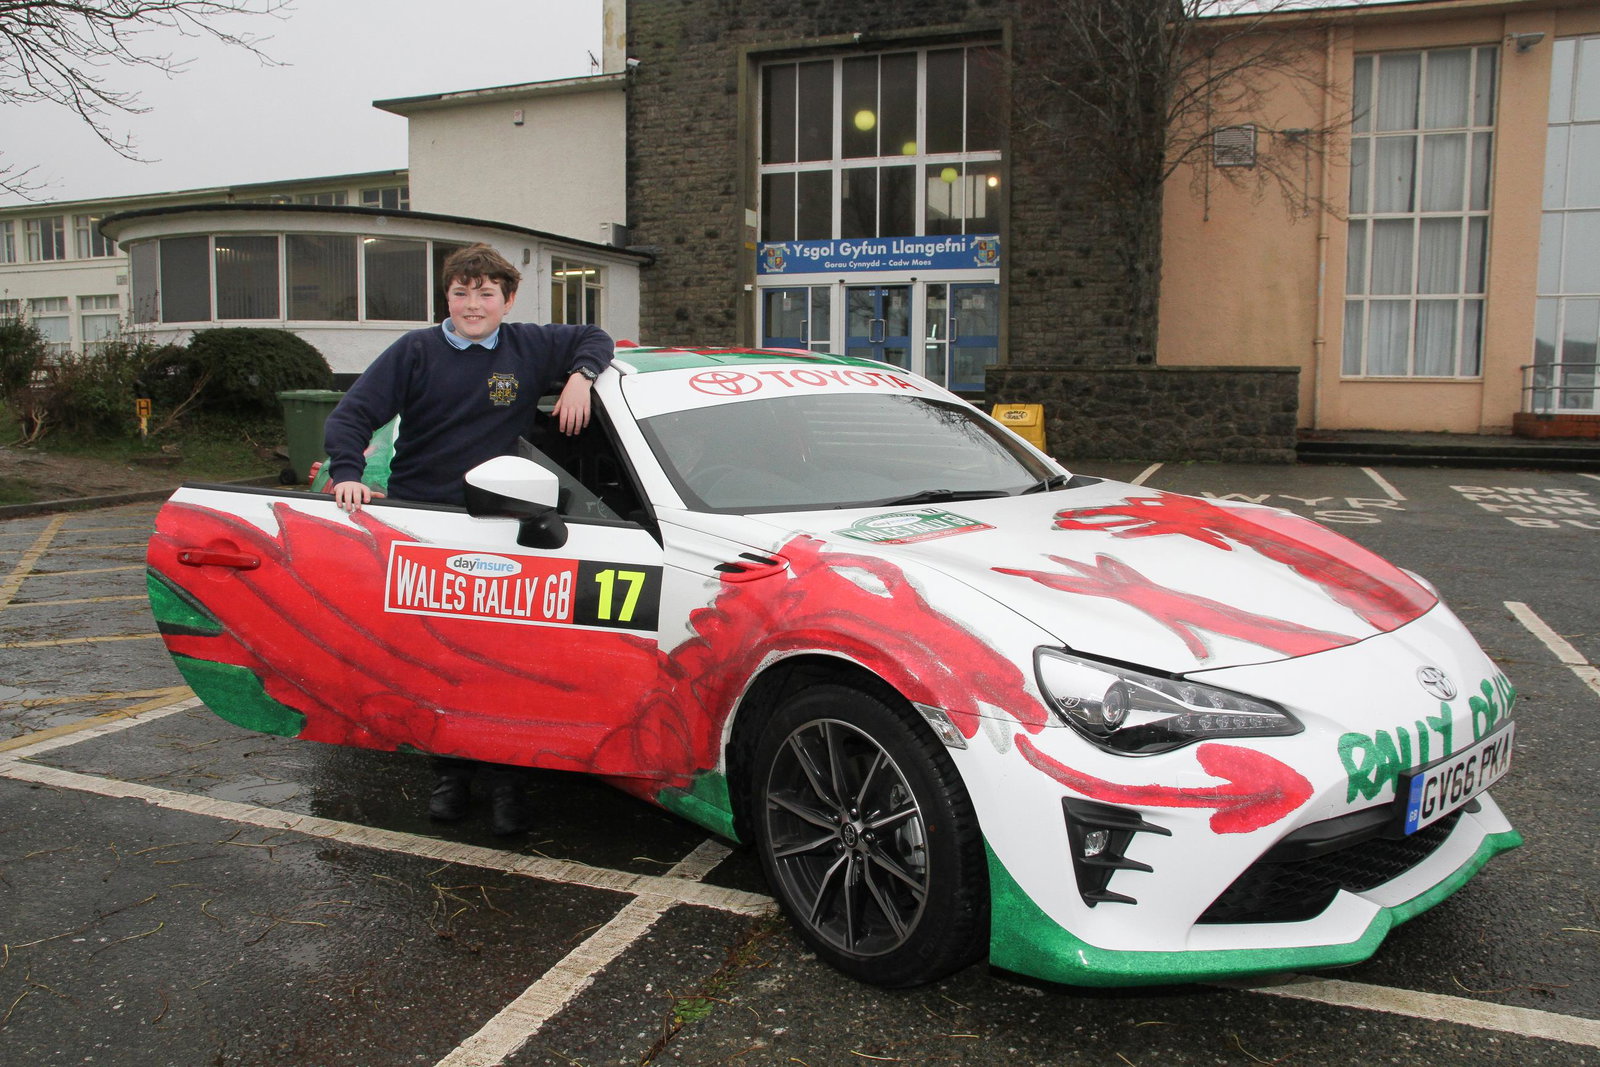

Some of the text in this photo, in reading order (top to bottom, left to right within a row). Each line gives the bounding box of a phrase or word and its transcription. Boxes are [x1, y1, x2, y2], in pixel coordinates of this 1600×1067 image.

[793, 238, 966, 260] Ysgol Gyfun Llangefni
[824, 261, 847, 269] Gorau
[848, 260, 880, 269] Cynnydd
[888, 259, 909, 267] Cadw
[911, 258, 931, 266] Moes
[758, 369, 923, 392] TOYOTA
[138, 400, 149, 415] H
[453, 557, 515, 572] dayinsure
[397, 555, 572, 620] WALES RALLY GB
[595, 569, 646, 622] 17
[1422, 755, 1477, 819] GV66
